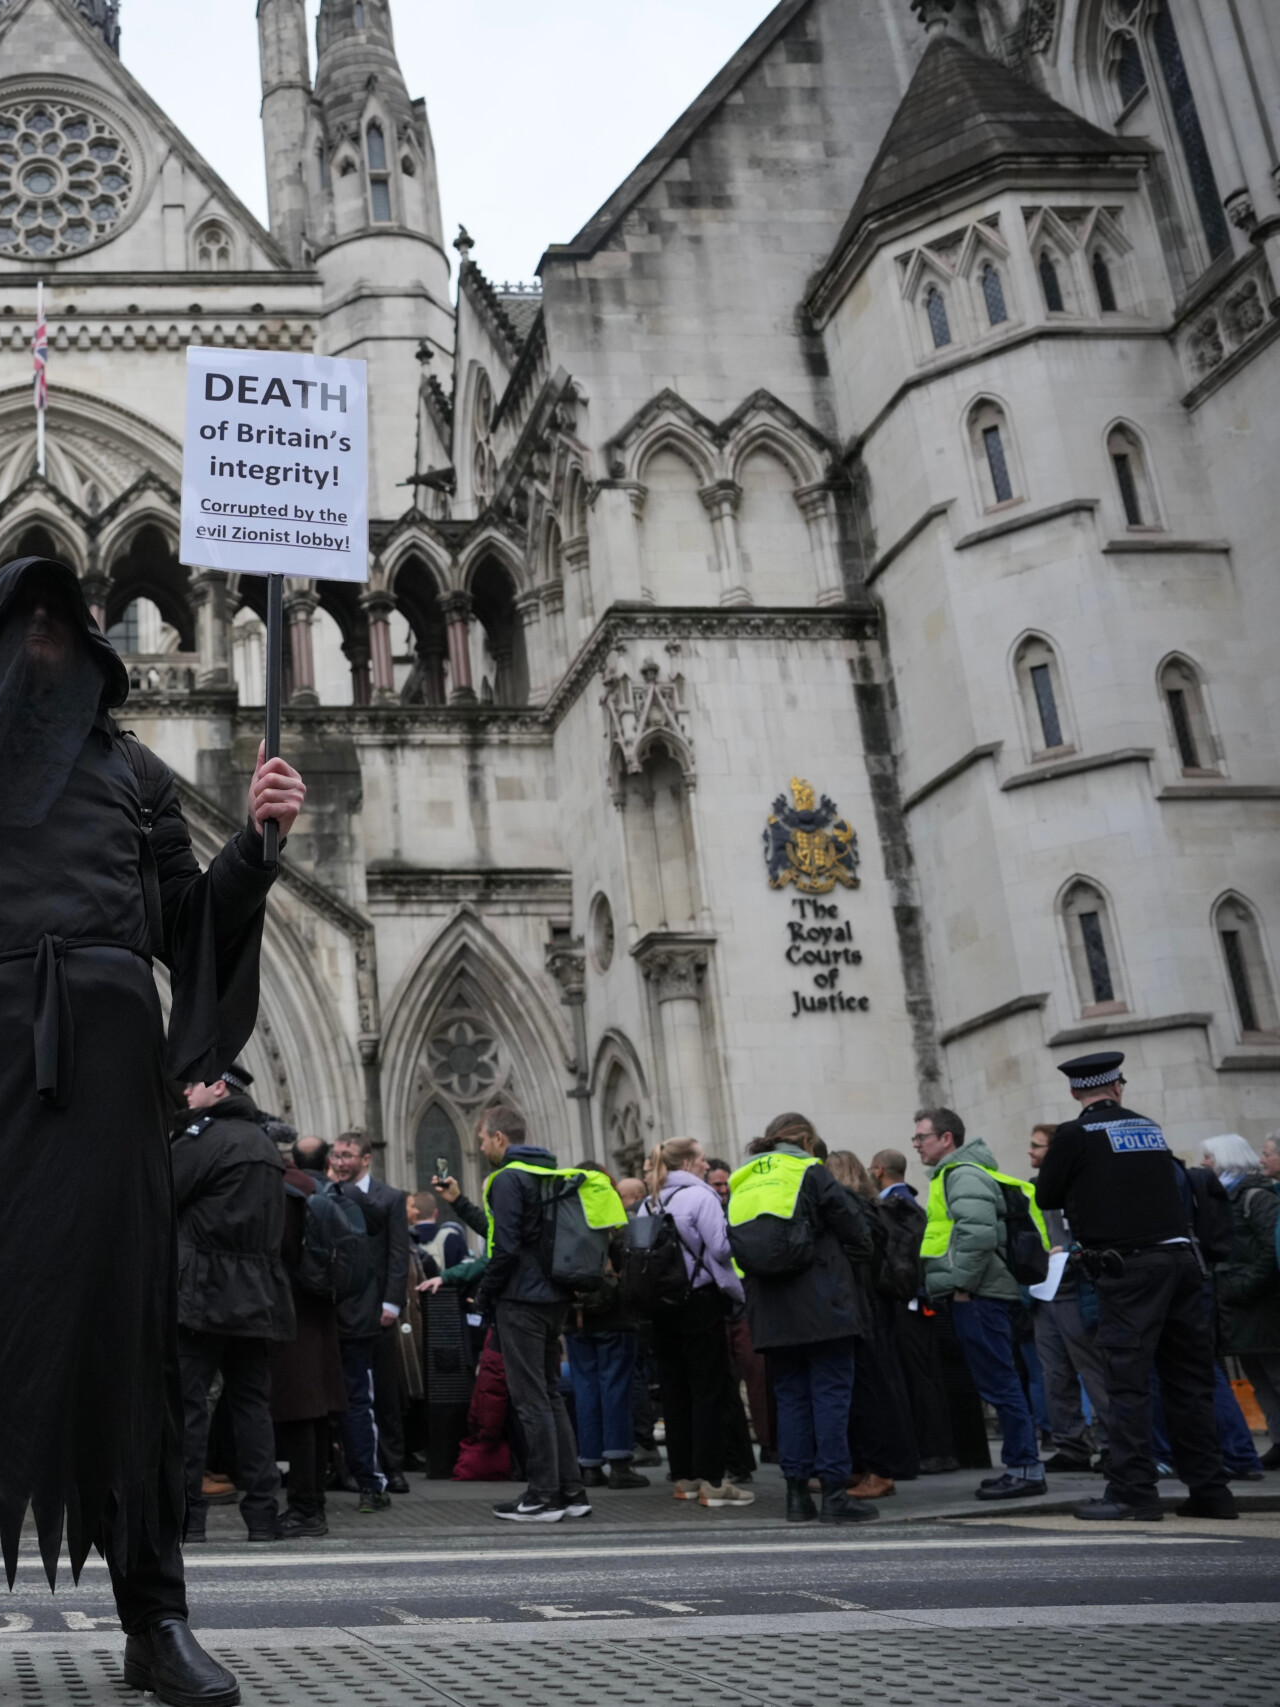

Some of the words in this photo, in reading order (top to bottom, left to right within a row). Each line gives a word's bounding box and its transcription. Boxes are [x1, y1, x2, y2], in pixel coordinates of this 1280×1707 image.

[205, 372, 347, 413] DEATH
[199, 421, 229, 441] of
[237, 423, 352, 452] Britain’s
[210, 456, 339, 490] integrity!
[200, 498, 289, 518] Corrupted
[294, 505, 315, 522] by
[319, 508, 348, 523] the
[196, 525, 227, 539] evil
[232, 526, 290, 543] Zionist
[295, 531, 350, 550] lobby!
[792, 898, 838, 920] The
[787, 920, 853, 946] Royal
[786, 945, 862, 966] Courts
[813, 967, 840, 989] of
[791, 990, 870, 1018] Justice
[1112, 1134, 1166, 1149] POLICE
